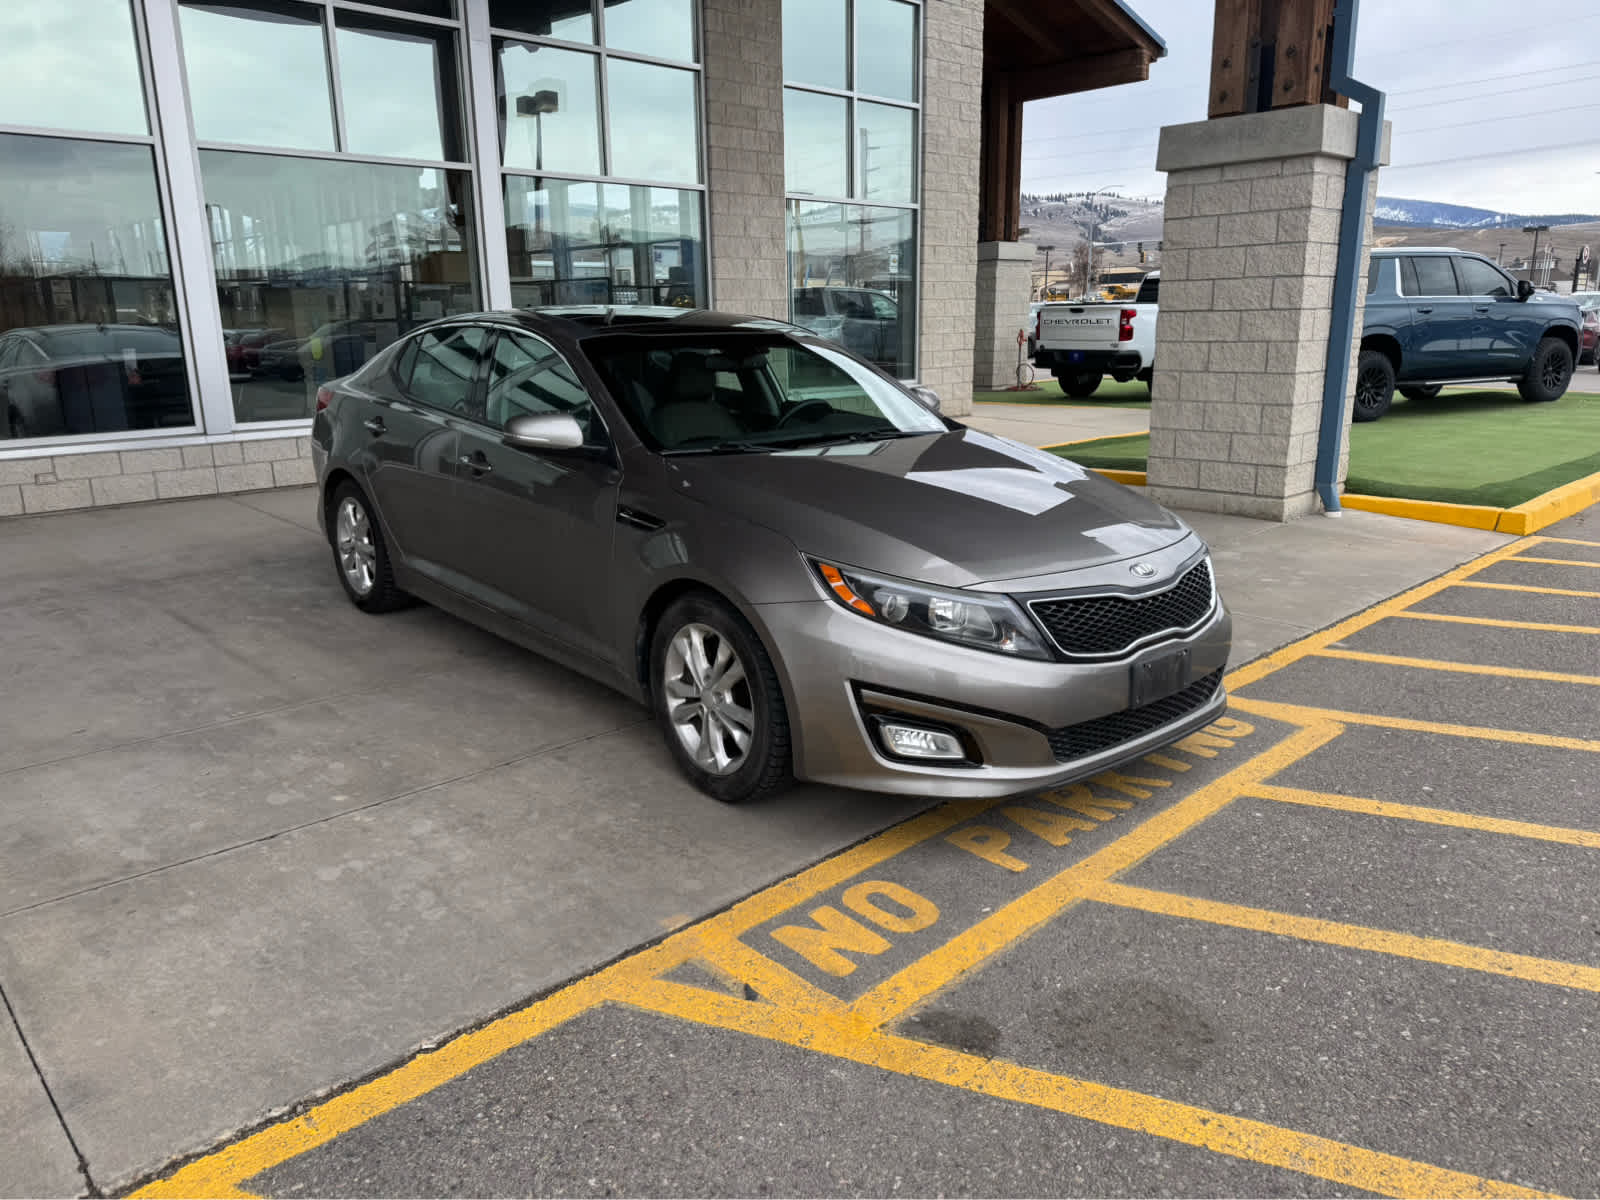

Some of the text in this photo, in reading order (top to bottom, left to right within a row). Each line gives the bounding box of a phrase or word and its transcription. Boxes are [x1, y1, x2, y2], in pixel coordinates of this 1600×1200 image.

[1043, 318, 1113, 326] CHEVROLET
[769, 716, 1255, 977] NO PARKING
